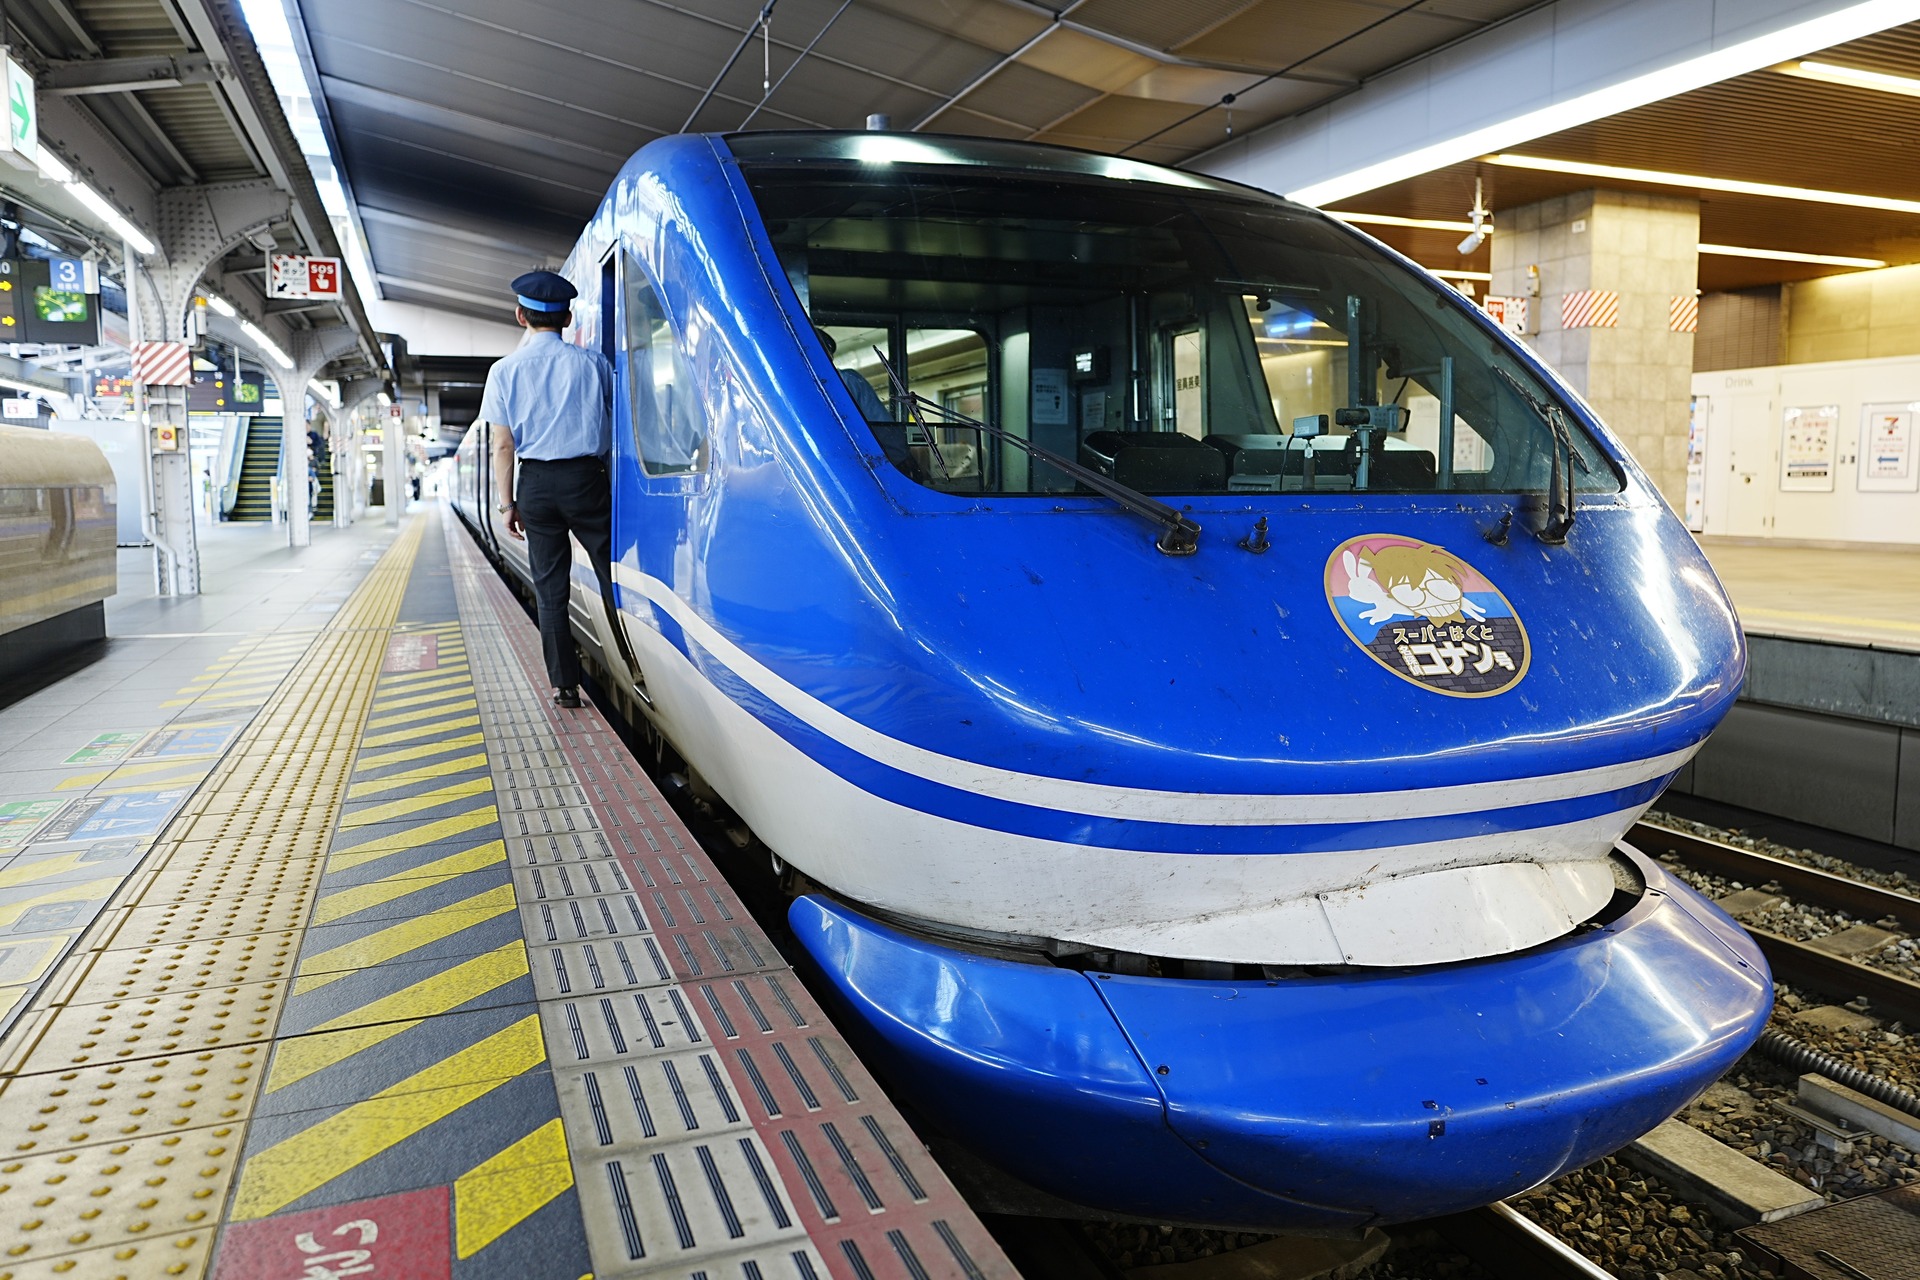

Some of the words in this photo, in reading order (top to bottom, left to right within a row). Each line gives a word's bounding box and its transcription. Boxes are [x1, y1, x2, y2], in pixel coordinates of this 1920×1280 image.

[0, 261, 11, 274] 0
[59, 261, 76, 282] 3
[310, 264, 334, 275] SOS
[1725, 375, 1754, 388] Drink
[1393, 625, 1494, 644] スーパーはくと
